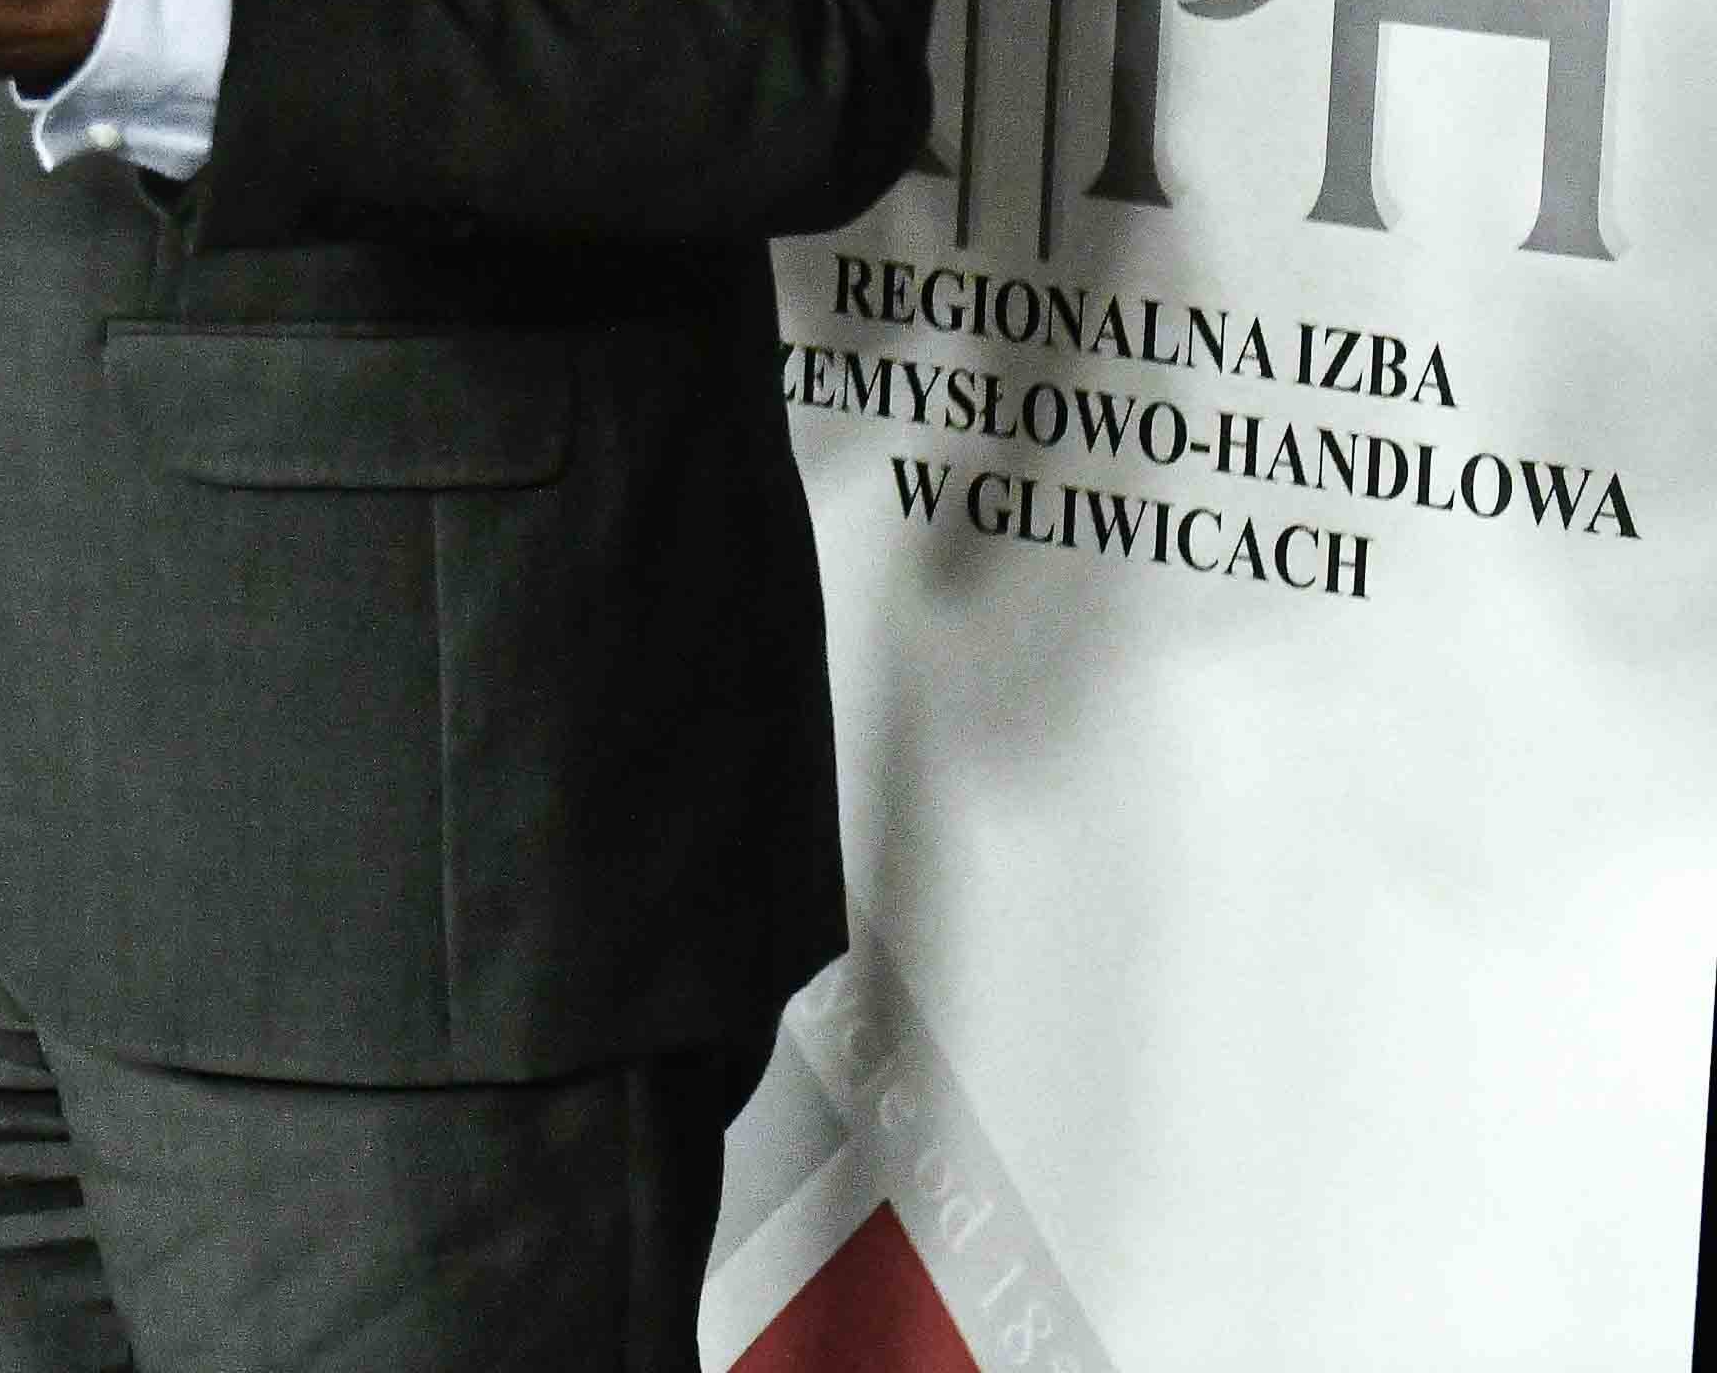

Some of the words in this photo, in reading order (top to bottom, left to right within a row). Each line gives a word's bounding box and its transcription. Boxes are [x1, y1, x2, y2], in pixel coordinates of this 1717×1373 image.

[833, 253, 1277, 381] REGIONALNA
[1296, 323, 1459, 410] IZBA
[890, 456, 951, 523] W
[965, 469, 1375, 601] GLIWICACH
